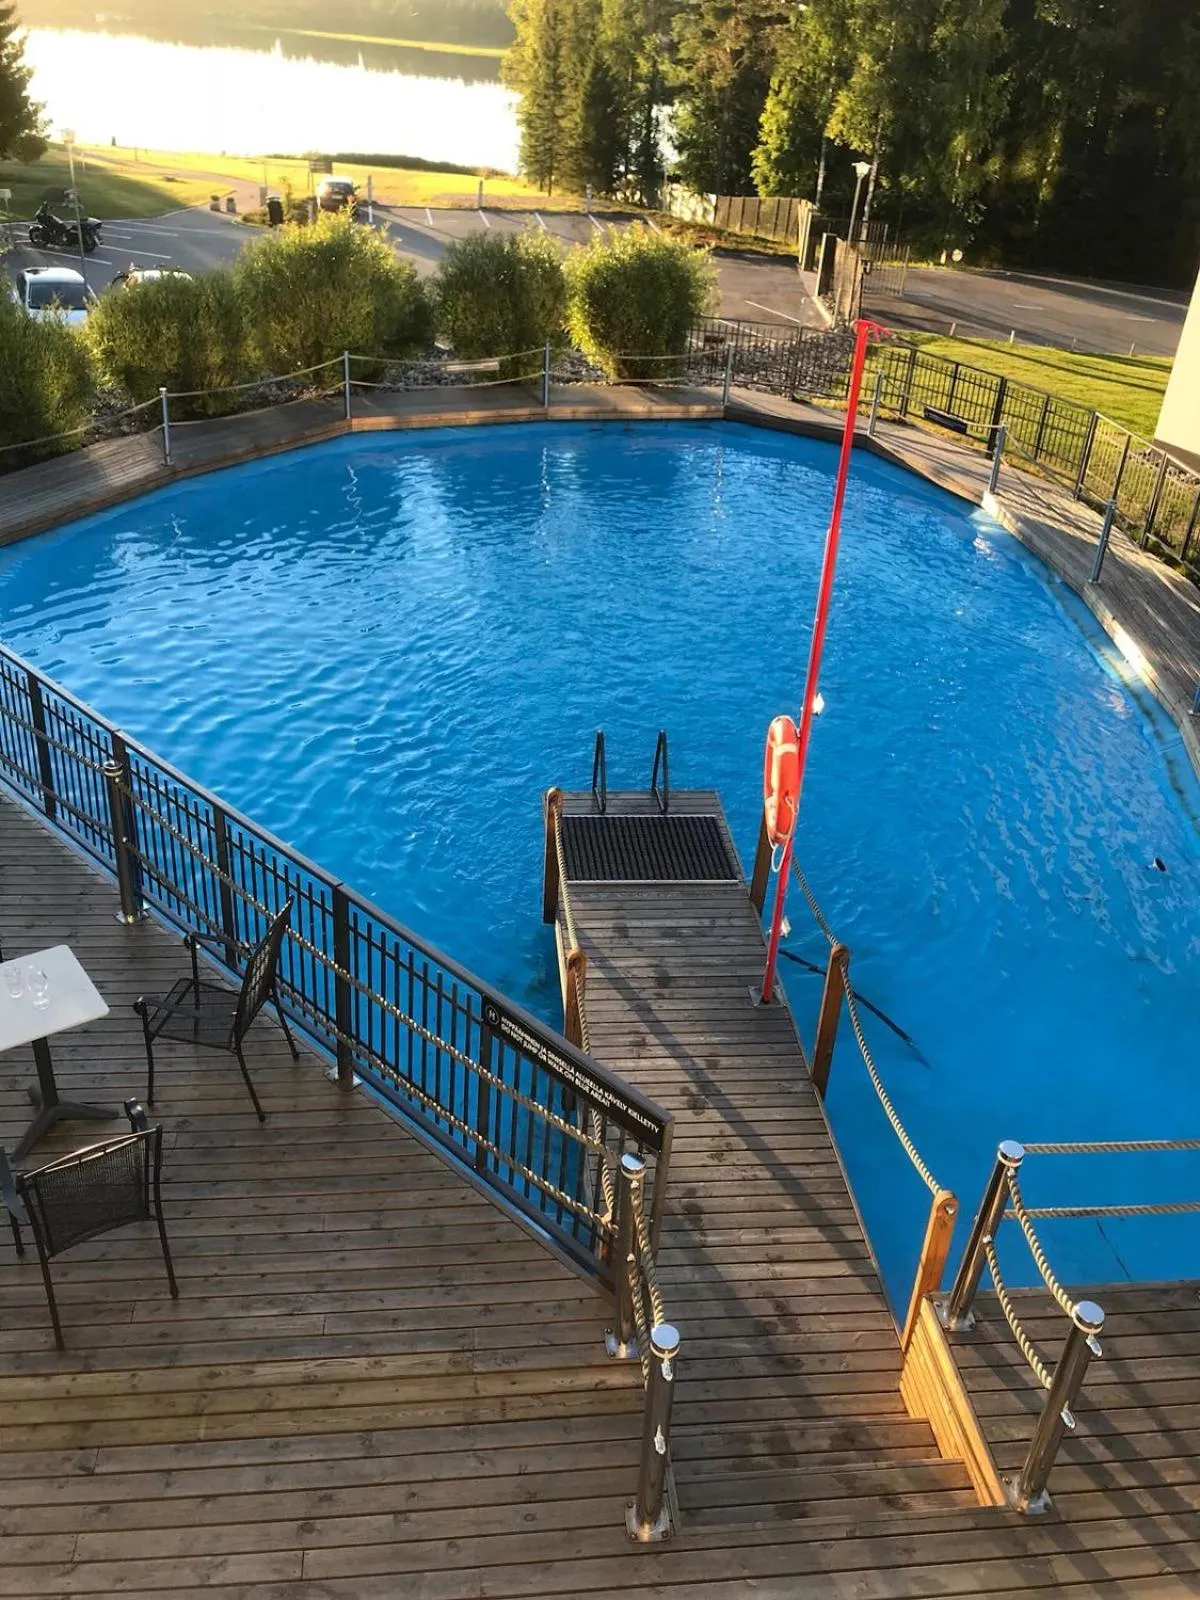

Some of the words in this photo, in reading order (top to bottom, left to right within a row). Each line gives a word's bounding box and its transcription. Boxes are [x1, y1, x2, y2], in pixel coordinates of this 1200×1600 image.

[501, 1023, 510, 1034] DO
[510, 1030, 523, 1044] NOT
[538, 1051, 547, 1062] OR
[547, 1058, 564, 1075] WALK
[563, 1071, 575, 1082] ON
[575, 1078, 590, 1094] BLUE
[575, 1071, 604, 1095] ALUEELLA
[604, 1091, 628, 1111] KÄVELY
[627, 1107, 660, 1133] KIELLETTY
